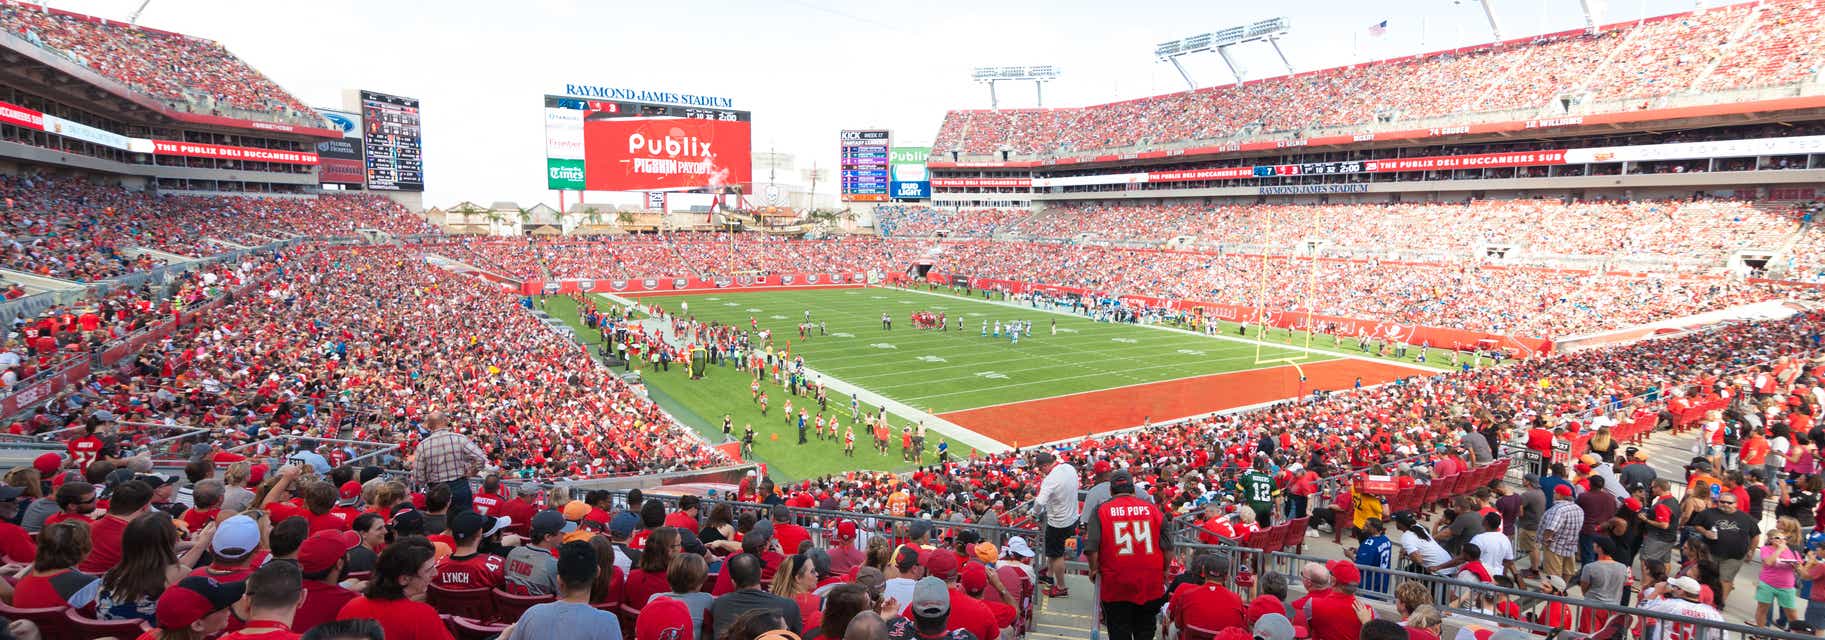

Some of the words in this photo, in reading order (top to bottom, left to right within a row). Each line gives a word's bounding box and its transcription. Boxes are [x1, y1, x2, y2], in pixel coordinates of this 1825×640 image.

[566, 83, 635, 100] RAYMOND
[637, 90, 679, 103] JAMES
[681, 94, 732, 108] STADIUM
[578, 101, 585, 109] 7
[608, 104, 616, 112] 3
[719, 113, 737, 121] 2:00
[841, 131, 861, 140] KICK
[629, 133, 712, 157] Publix
[156, 143, 177, 152] THE
[181, 145, 216, 154] PUBLIX
[219, 148, 241, 157] DELI
[243, 150, 299, 161] BUCCANEERS
[302, 154, 318, 162] SUB
[1400, 160, 1433, 168] PUBLIX
[1437, 158, 1459, 167] DELI
[1463, 155, 1534, 166] BUCCANEERS
[1539, 153, 1562, 162] SUB
[550, 167, 584, 179] Times
[1197, 170, 1237, 178] BUCCANEERS
[1340, 164, 1360, 173] 2:00
[1259, 186, 1299, 195] RAYMOND
[1300, 185, 1328, 193] JAMES
[1329, 184, 1369, 193] STADIUM
[1252, 482, 1271, 502] 12
[892, 502, 906, 513] 63
[1111, 507, 1125, 516] BIG
[1127, 506, 1150, 516] POPS
[1113, 520, 1153, 555] 54
[485, 555, 502, 572] 47
[509, 559, 534, 577] EVANS
[442, 572, 469, 584] LYNCH
